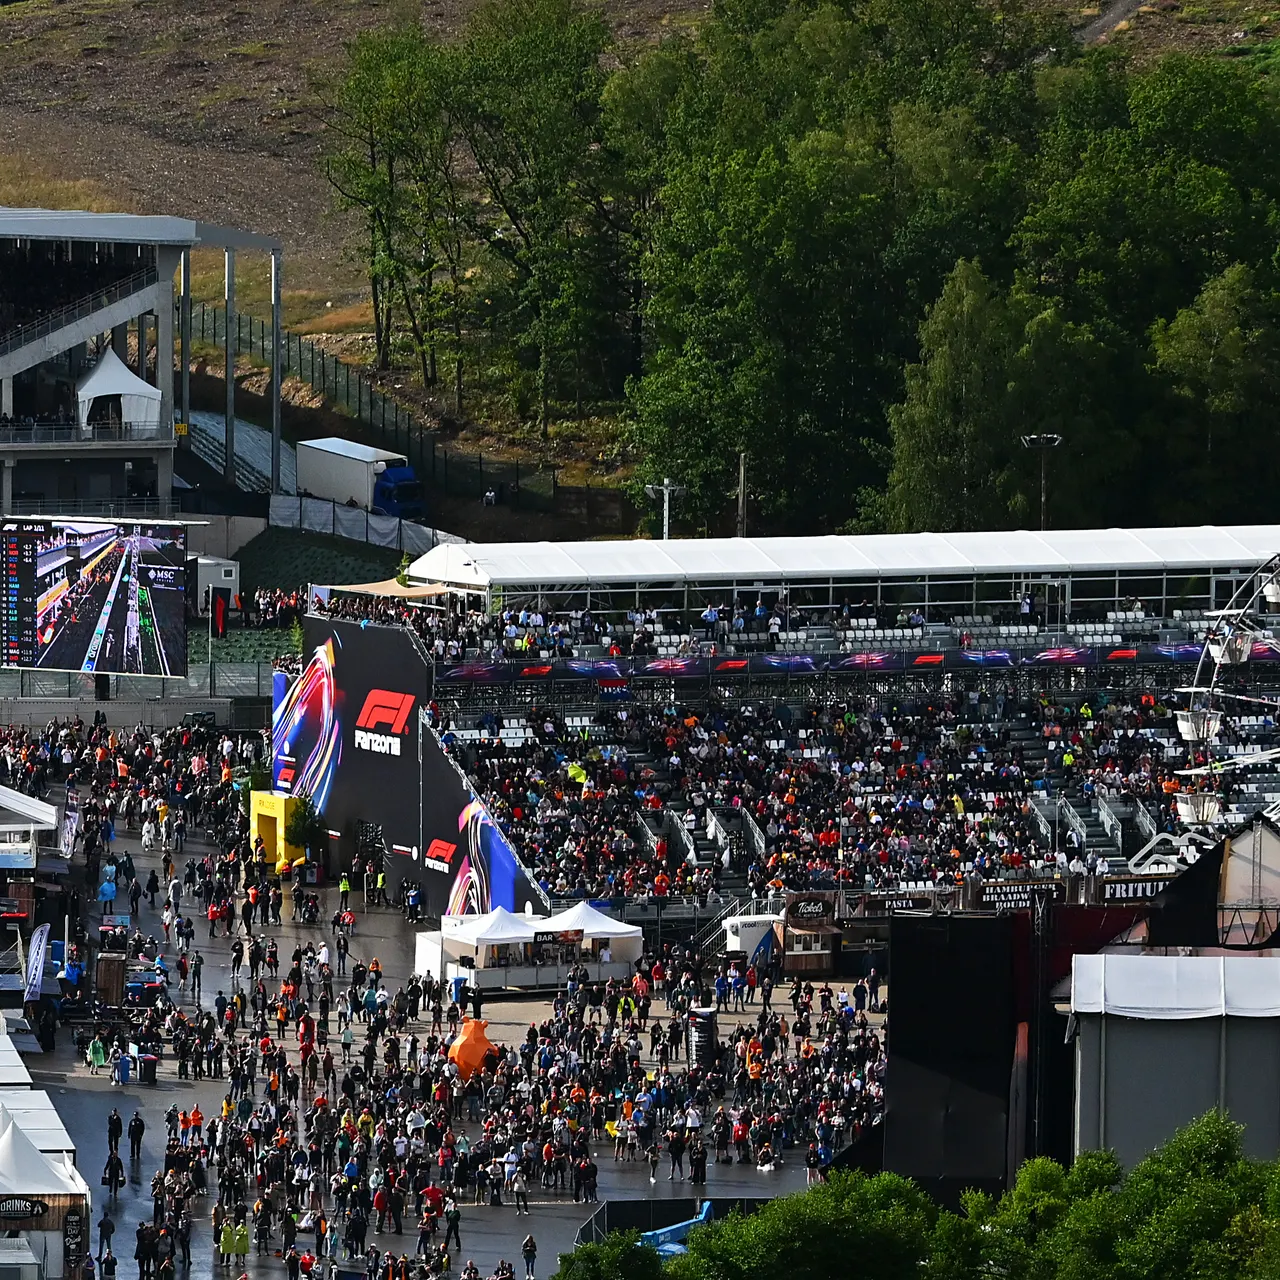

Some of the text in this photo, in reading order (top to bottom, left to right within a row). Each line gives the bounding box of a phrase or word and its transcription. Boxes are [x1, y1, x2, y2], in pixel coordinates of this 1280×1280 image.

[157, 571, 175, 580] MSC
[797, 902, 823, 913] Tickets
[885, 900, 913, 909] PASTA
[536, 934, 553, 942] BAR
[0, 1199, 32, 1212] DRINKS
